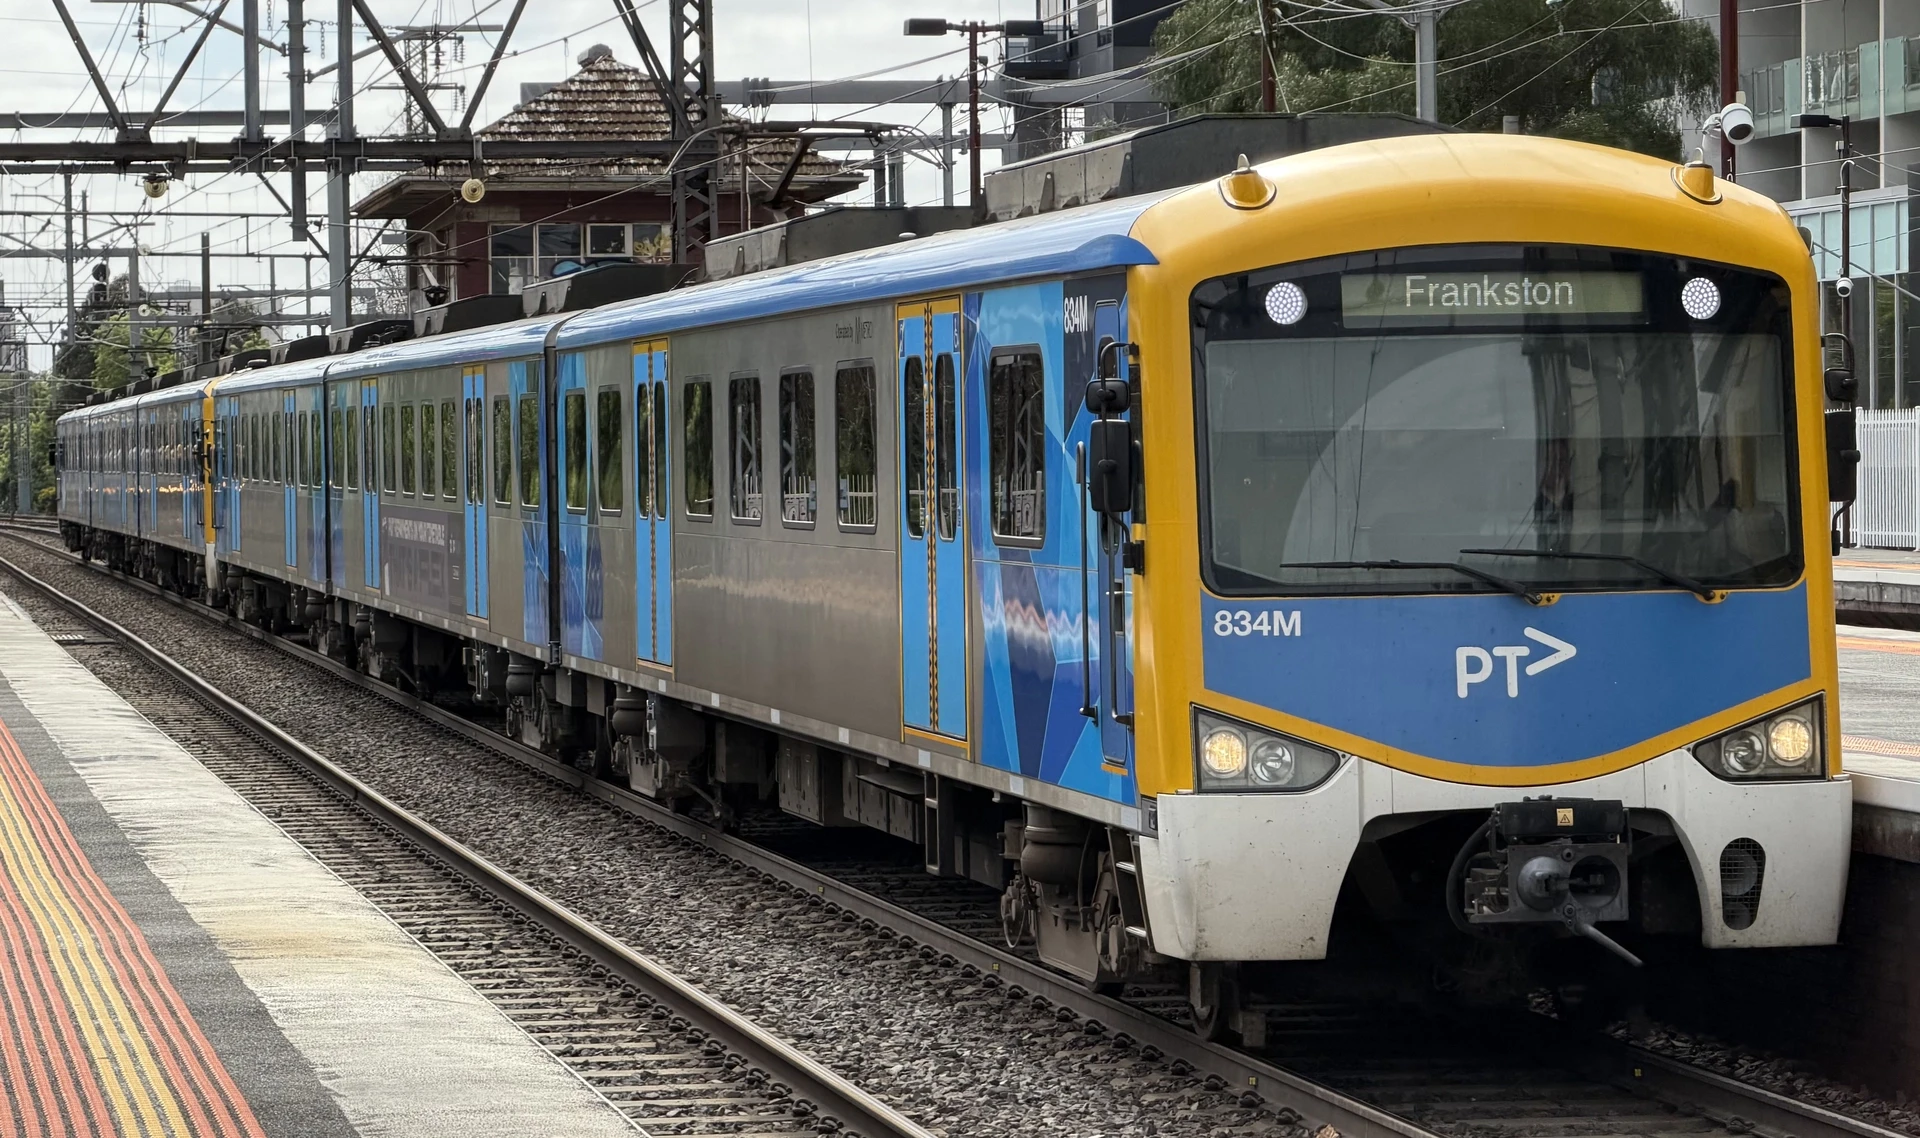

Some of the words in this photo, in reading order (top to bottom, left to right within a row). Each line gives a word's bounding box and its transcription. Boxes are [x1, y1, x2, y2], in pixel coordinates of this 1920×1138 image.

[1406, 275, 1573, 307] Frankston
[1064, 295, 1088, 334] 834M
[1214, 610, 1301, 637] 834M
